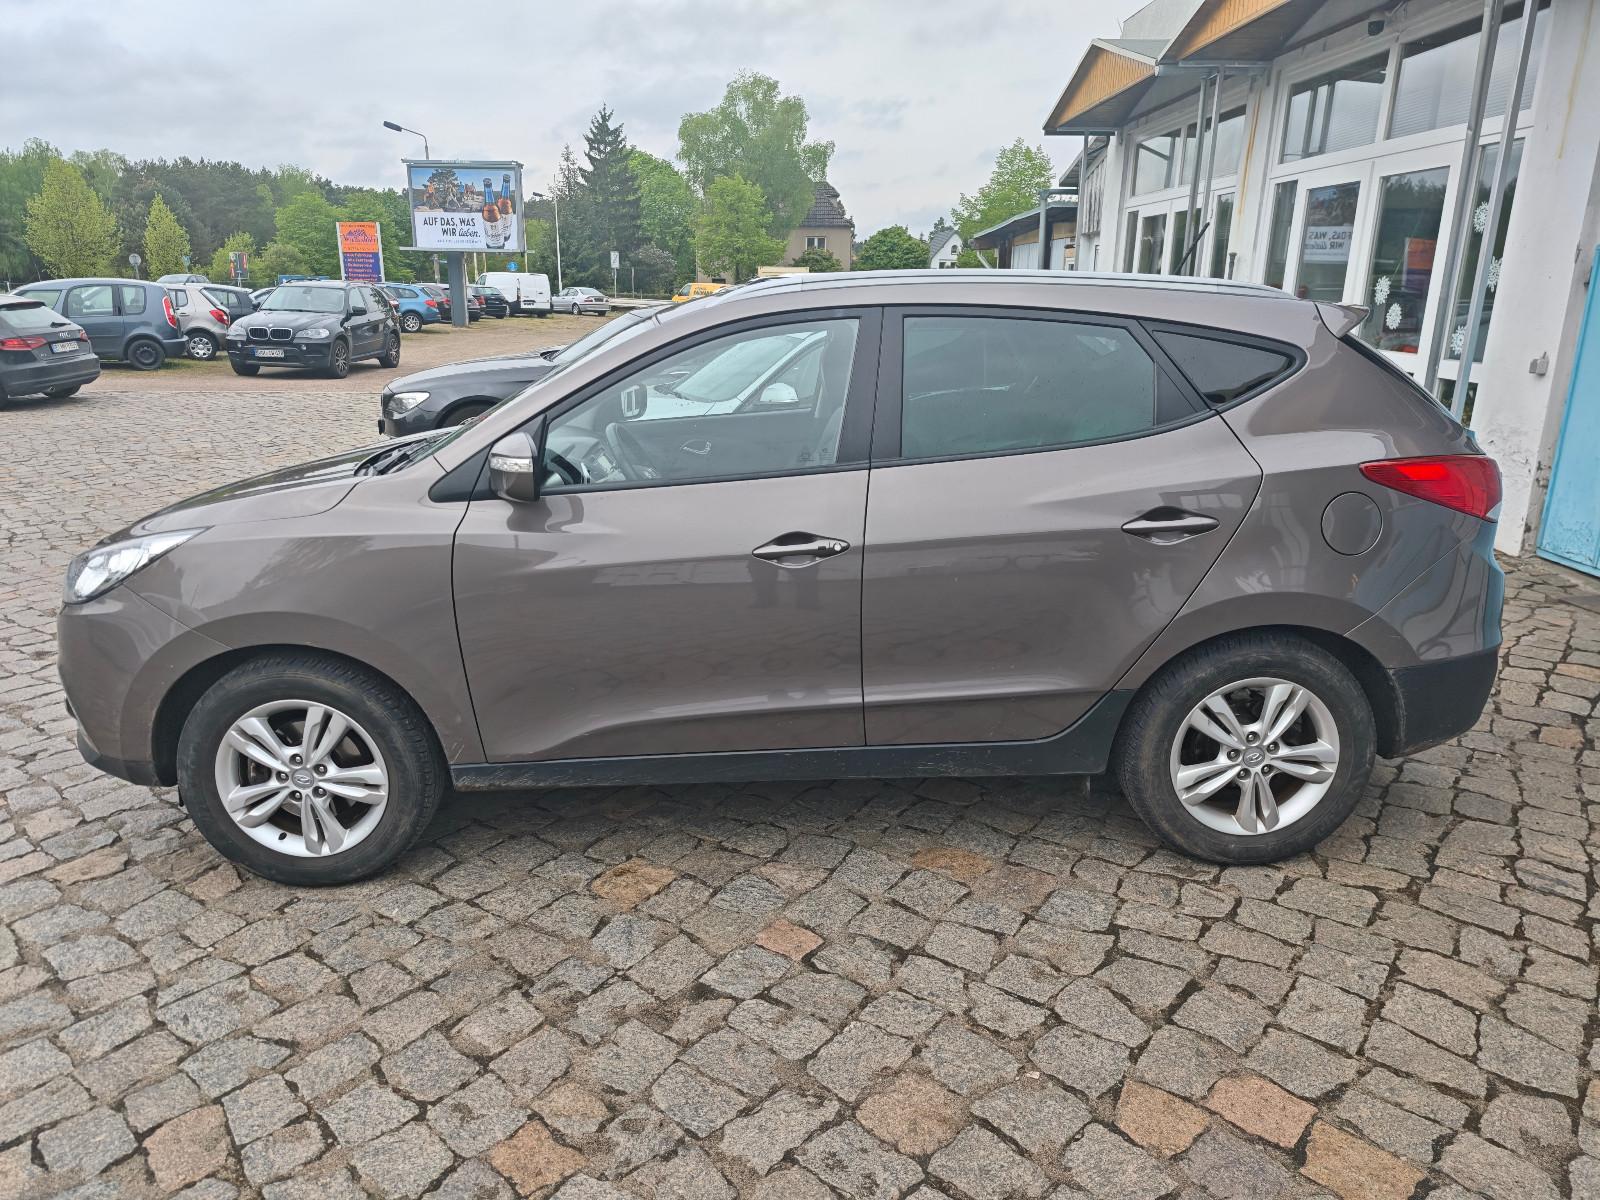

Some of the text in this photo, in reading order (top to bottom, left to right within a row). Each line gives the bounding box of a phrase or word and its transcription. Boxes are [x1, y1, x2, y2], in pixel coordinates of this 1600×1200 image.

[423, 217, 476, 227] AUF DAS, WAS
[441, 228, 457, 237] WIR
[458, 228, 481, 238] lieben.
